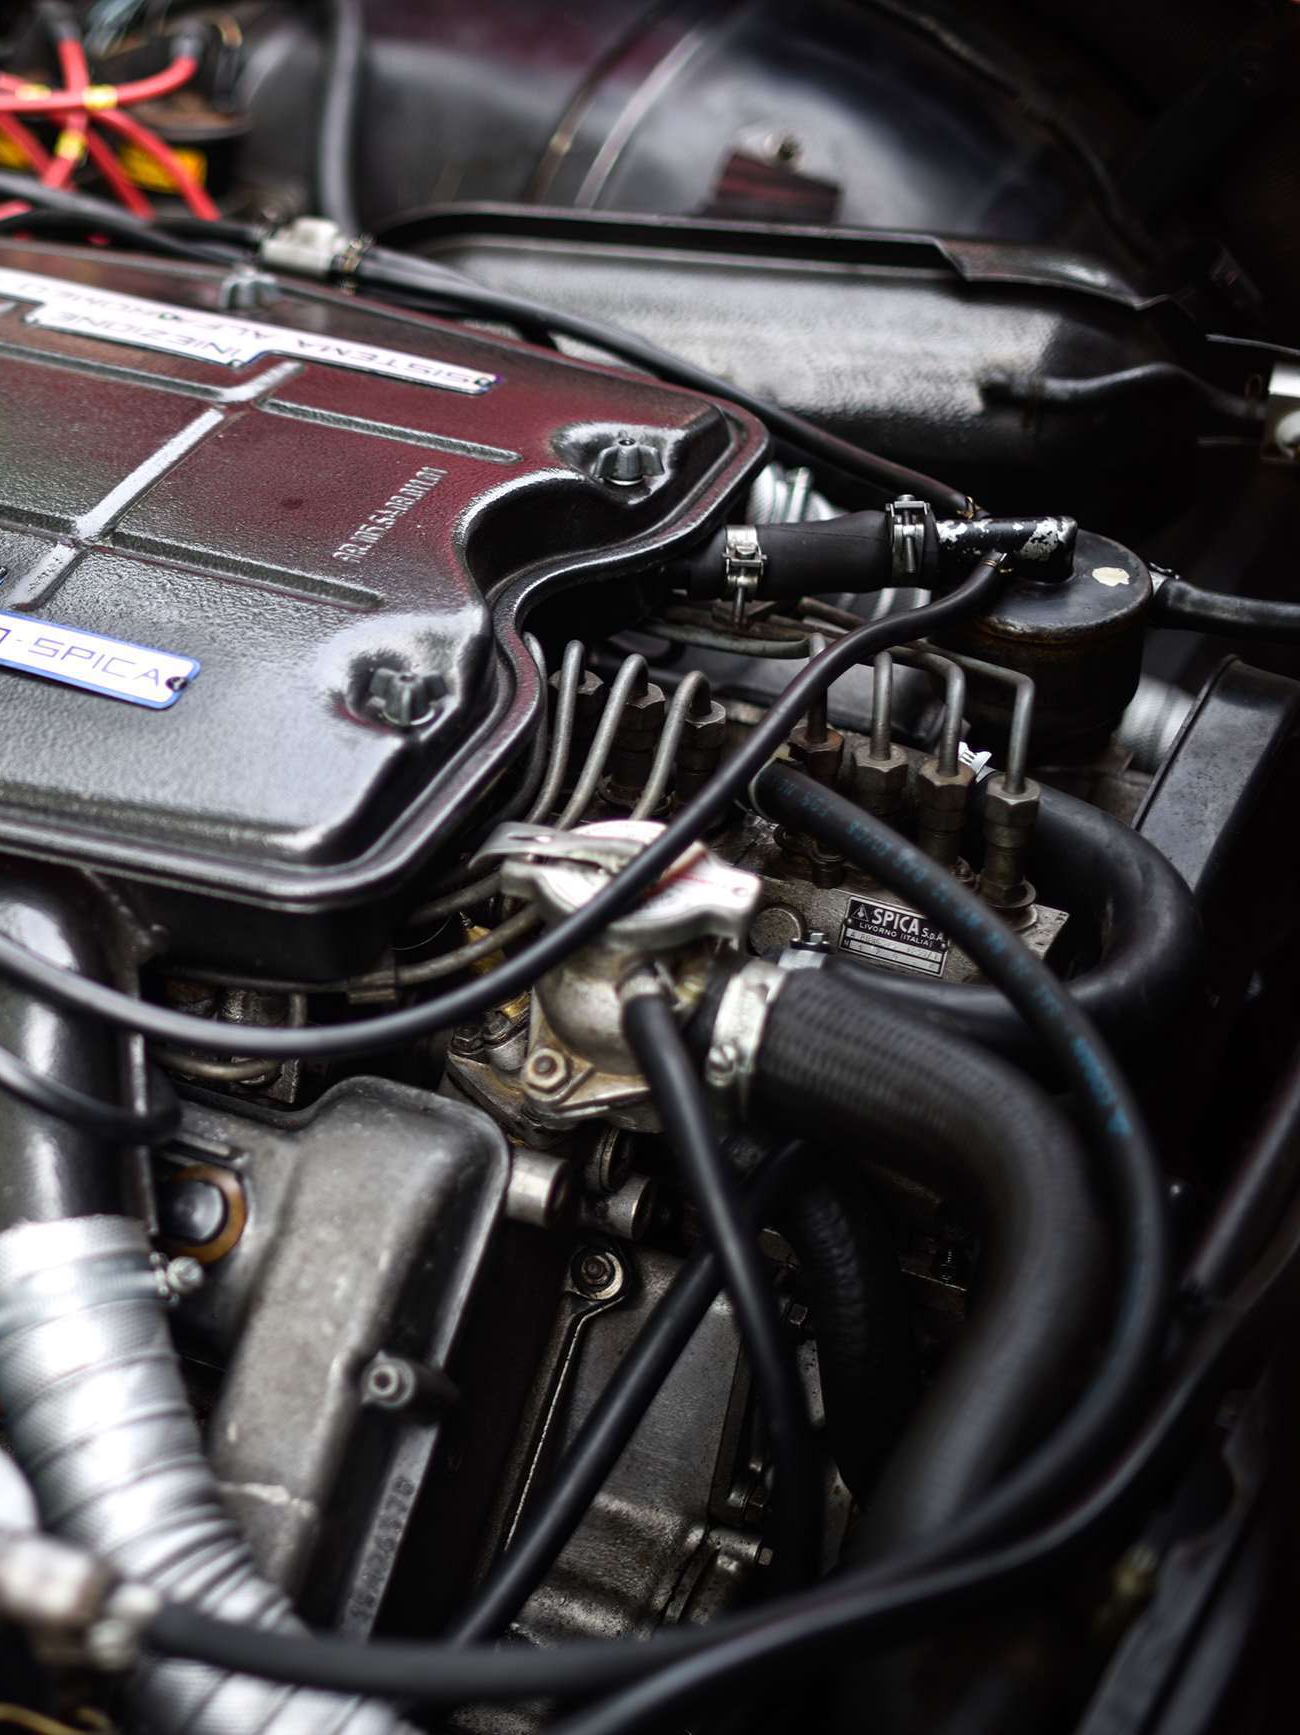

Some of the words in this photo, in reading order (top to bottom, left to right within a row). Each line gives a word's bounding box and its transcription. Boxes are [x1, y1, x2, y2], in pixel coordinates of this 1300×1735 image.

[859, 922, 898, 938] LIVORNO
[900, 933, 934, 948] (ITALIA)
[871, 908, 919, 936] SPICA
